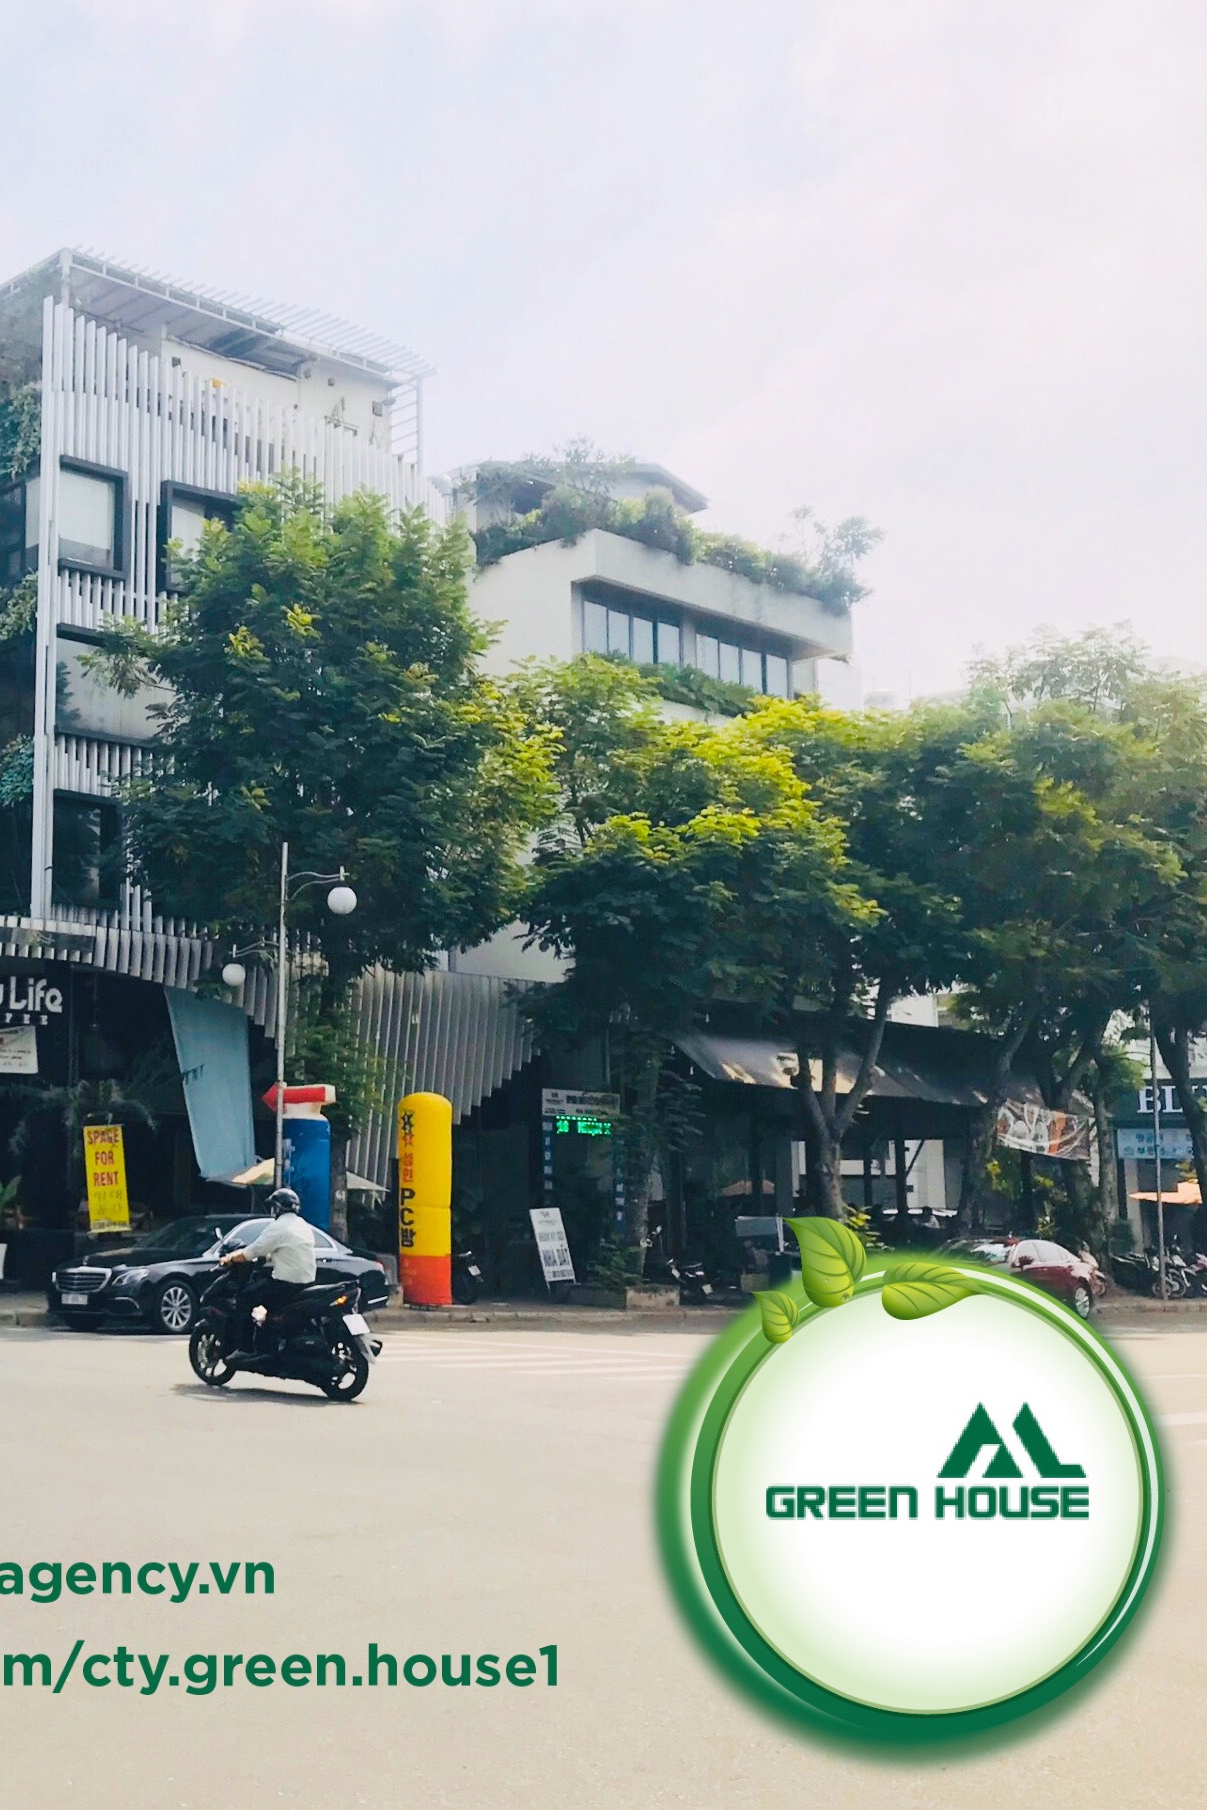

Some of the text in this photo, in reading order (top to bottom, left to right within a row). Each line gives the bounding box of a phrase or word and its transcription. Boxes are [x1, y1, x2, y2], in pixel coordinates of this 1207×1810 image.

[9, 976, 63, 1012] Life
[95, 1151, 115, 1166] FOR
[93, 1171, 119, 1187] RENT
